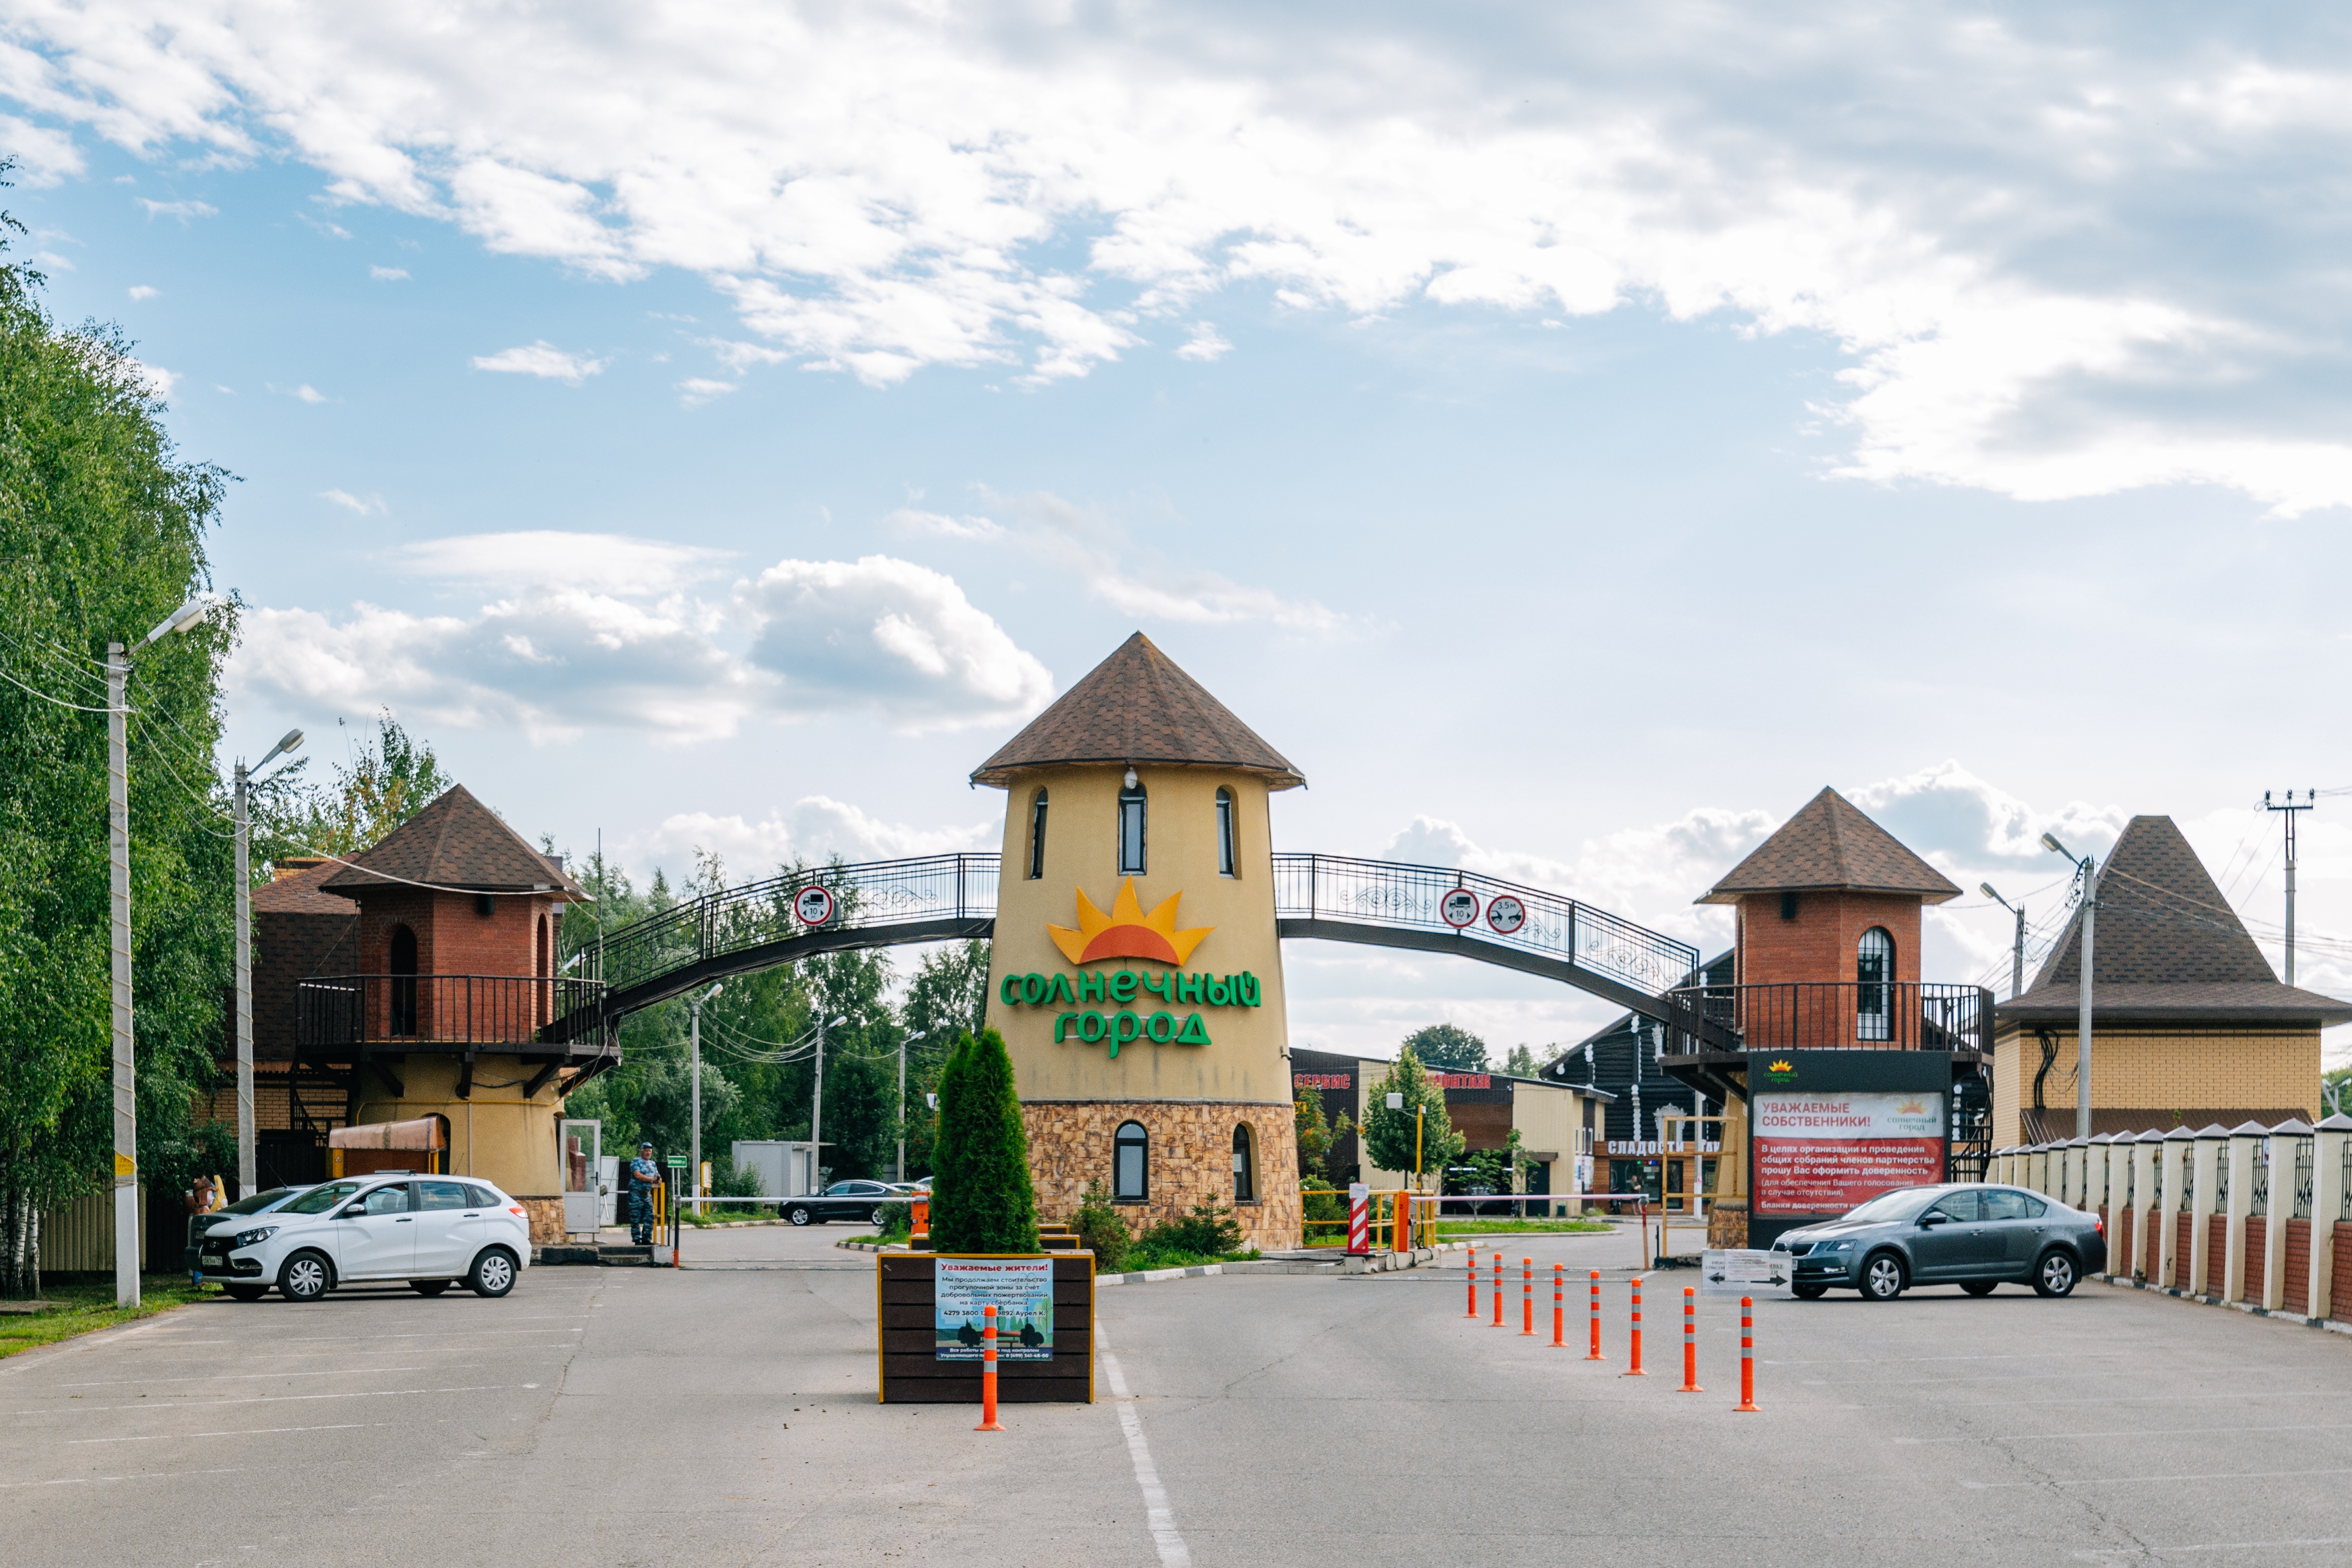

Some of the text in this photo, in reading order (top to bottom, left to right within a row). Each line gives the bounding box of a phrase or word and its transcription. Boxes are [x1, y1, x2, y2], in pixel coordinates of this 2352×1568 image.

[1000, 970, 1261, 1007] солнечный
[1055, 1010, 1212, 1059] город
[1294, 1074, 1351, 1089] СЕРВИС
[1762, 1102, 1850, 1113] УВАЖАЕМЫЕ
[1762, 1115, 1871, 1127] СОБСТВЕННИКИ!
[1608, 1140, 1684, 1156] СЛАДОСТИ
[1761, 1145, 1768, 1153] В
[1770, 1146, 1797, 1155] целях
[1800, 1146, 1859, 1156] организации
[1869, 1146, 1925, 1155] проведения
[1761, 1156, 1792, 1165] общих
[1794, 1155, 1838, 1165] собраний
[1876, 1157, 1935, 1165] партнерства
[1761, 1166, 1928, 1176] прошу Вас оформить доверенность
[1761, 1178, 1779, 1187] (для
[1781, 1178, 1831, 1187] обеспечения
[1792, 1202, 1848, 1210] доверенности
[941, 1263, 1002, 1271] Уважаемые
